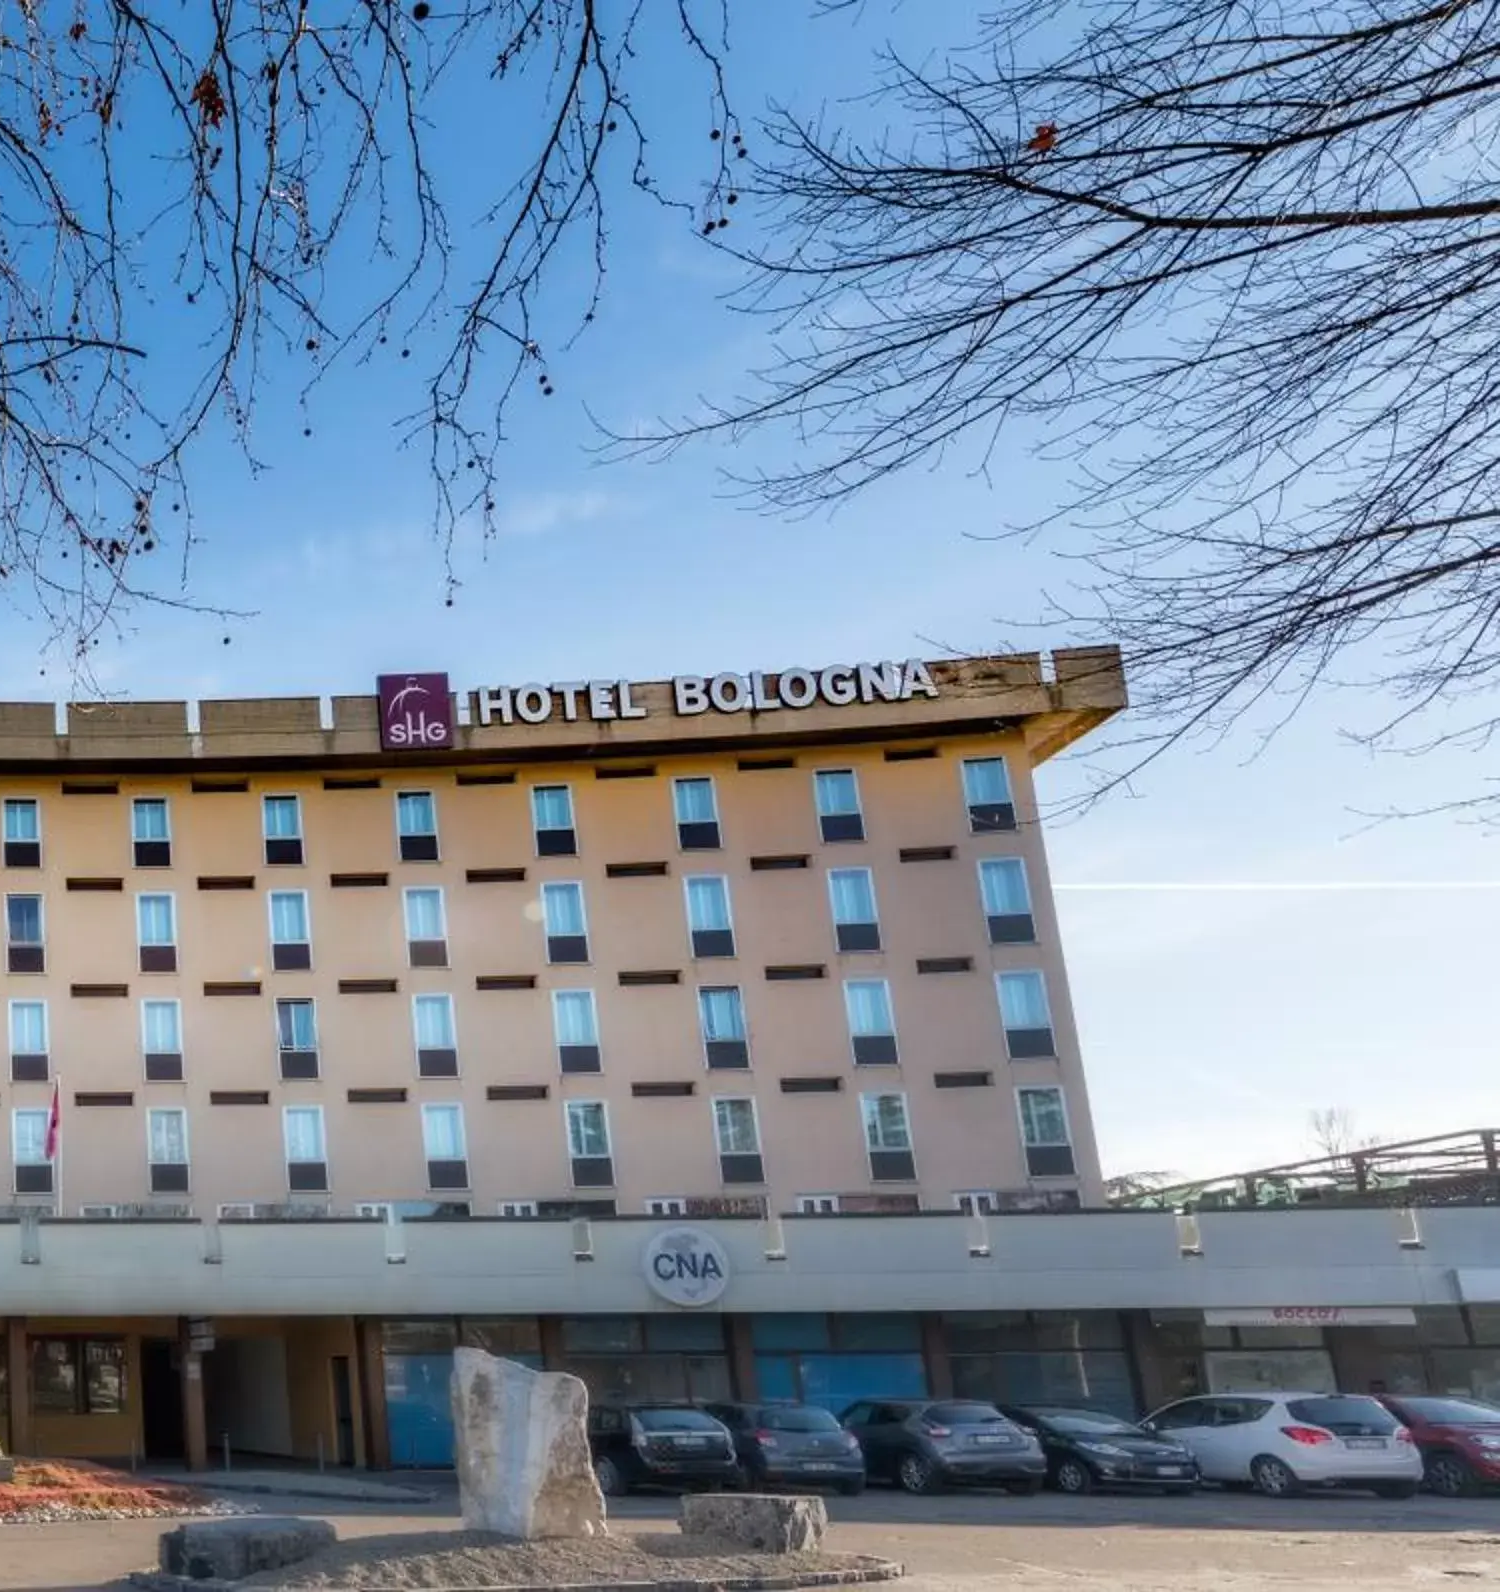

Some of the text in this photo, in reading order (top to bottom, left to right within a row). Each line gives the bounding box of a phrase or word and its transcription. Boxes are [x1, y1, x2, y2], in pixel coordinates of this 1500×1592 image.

[478, 658, 939, 725] HOTEL BOLOGNA
[389, 711, 446, 744] SHG
[653, 1252, 723, 1280] CNA
